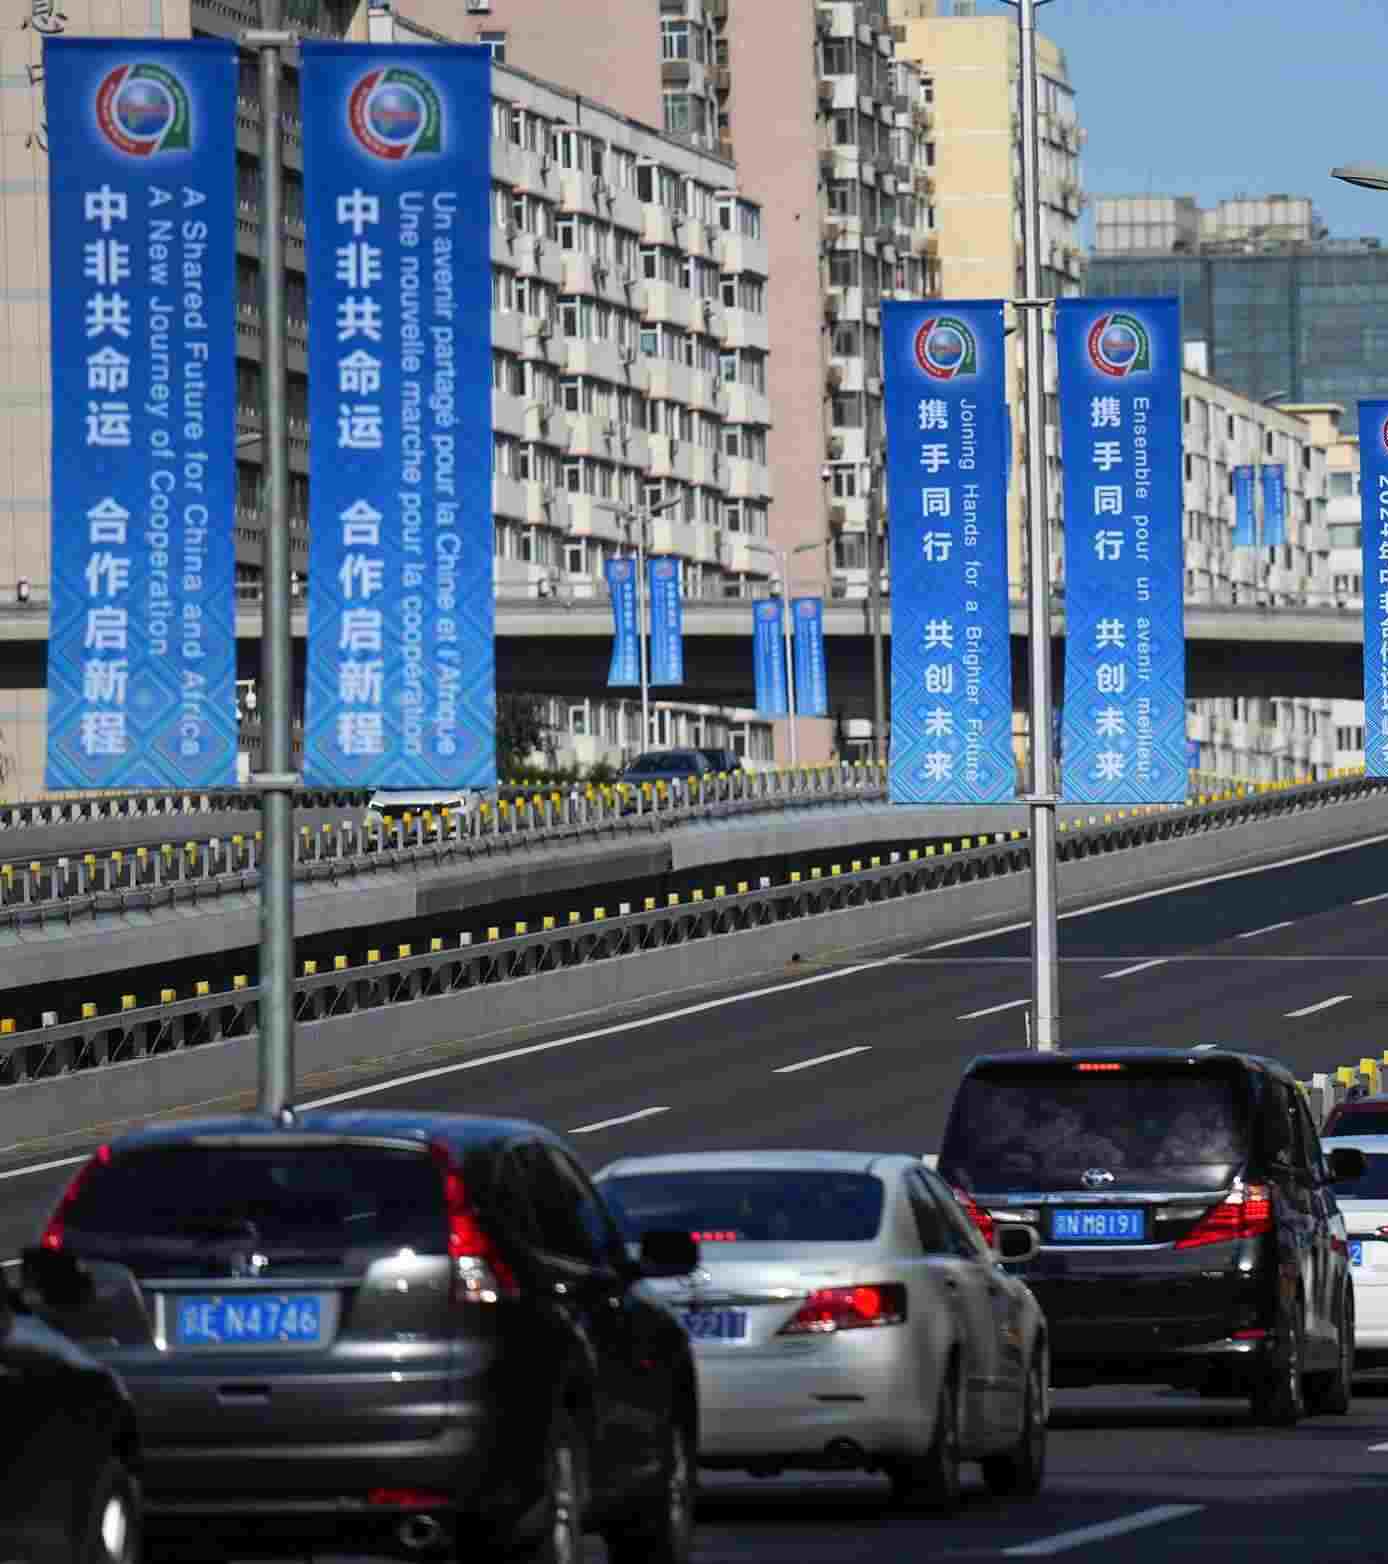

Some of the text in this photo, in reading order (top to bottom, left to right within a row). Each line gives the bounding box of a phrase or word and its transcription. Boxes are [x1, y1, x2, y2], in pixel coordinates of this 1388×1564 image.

[398, 191, 424, 246] Une
[432, 191, 457, 232] Un
[399, 257, 424, 374] nouvelle
[432, 237, 456, 321] avenir
[144, 186, 175, 656] A New Journey of Cooperation
[400, 381, 424, 484] marche
[430, 432, 457, 496] pour
[1132, 397, 1152, 499] Ensemble
[79, 184, 132, 756] 中非共命运 合作启新程
[180, 186, 209, 756] A Shared Future for China and Africa
[335, 188, 384, 756] 中非共命运 合作启新程
[435, 503, 461, 527] la
[918, 398, 953, 561] 携手同行
[1090, 396, 1125, 561] 携手同行
[396, 492, 422, 554] pour
[1131, 515, 1151, 561] pour
[400, 561, 424, 587] la
[435, 533, 461, 609] Chine
[959, 399, 984, 783] Joining Hands for a Brighter Future
[1135, 577, 1151, 601] un
[435, 618, 459, 640] et
[1135, 617, 1154, 680] avenir
[924, 618, 953, 782] 共创未来
[1095, 618, 1127, 781] 共创未来
